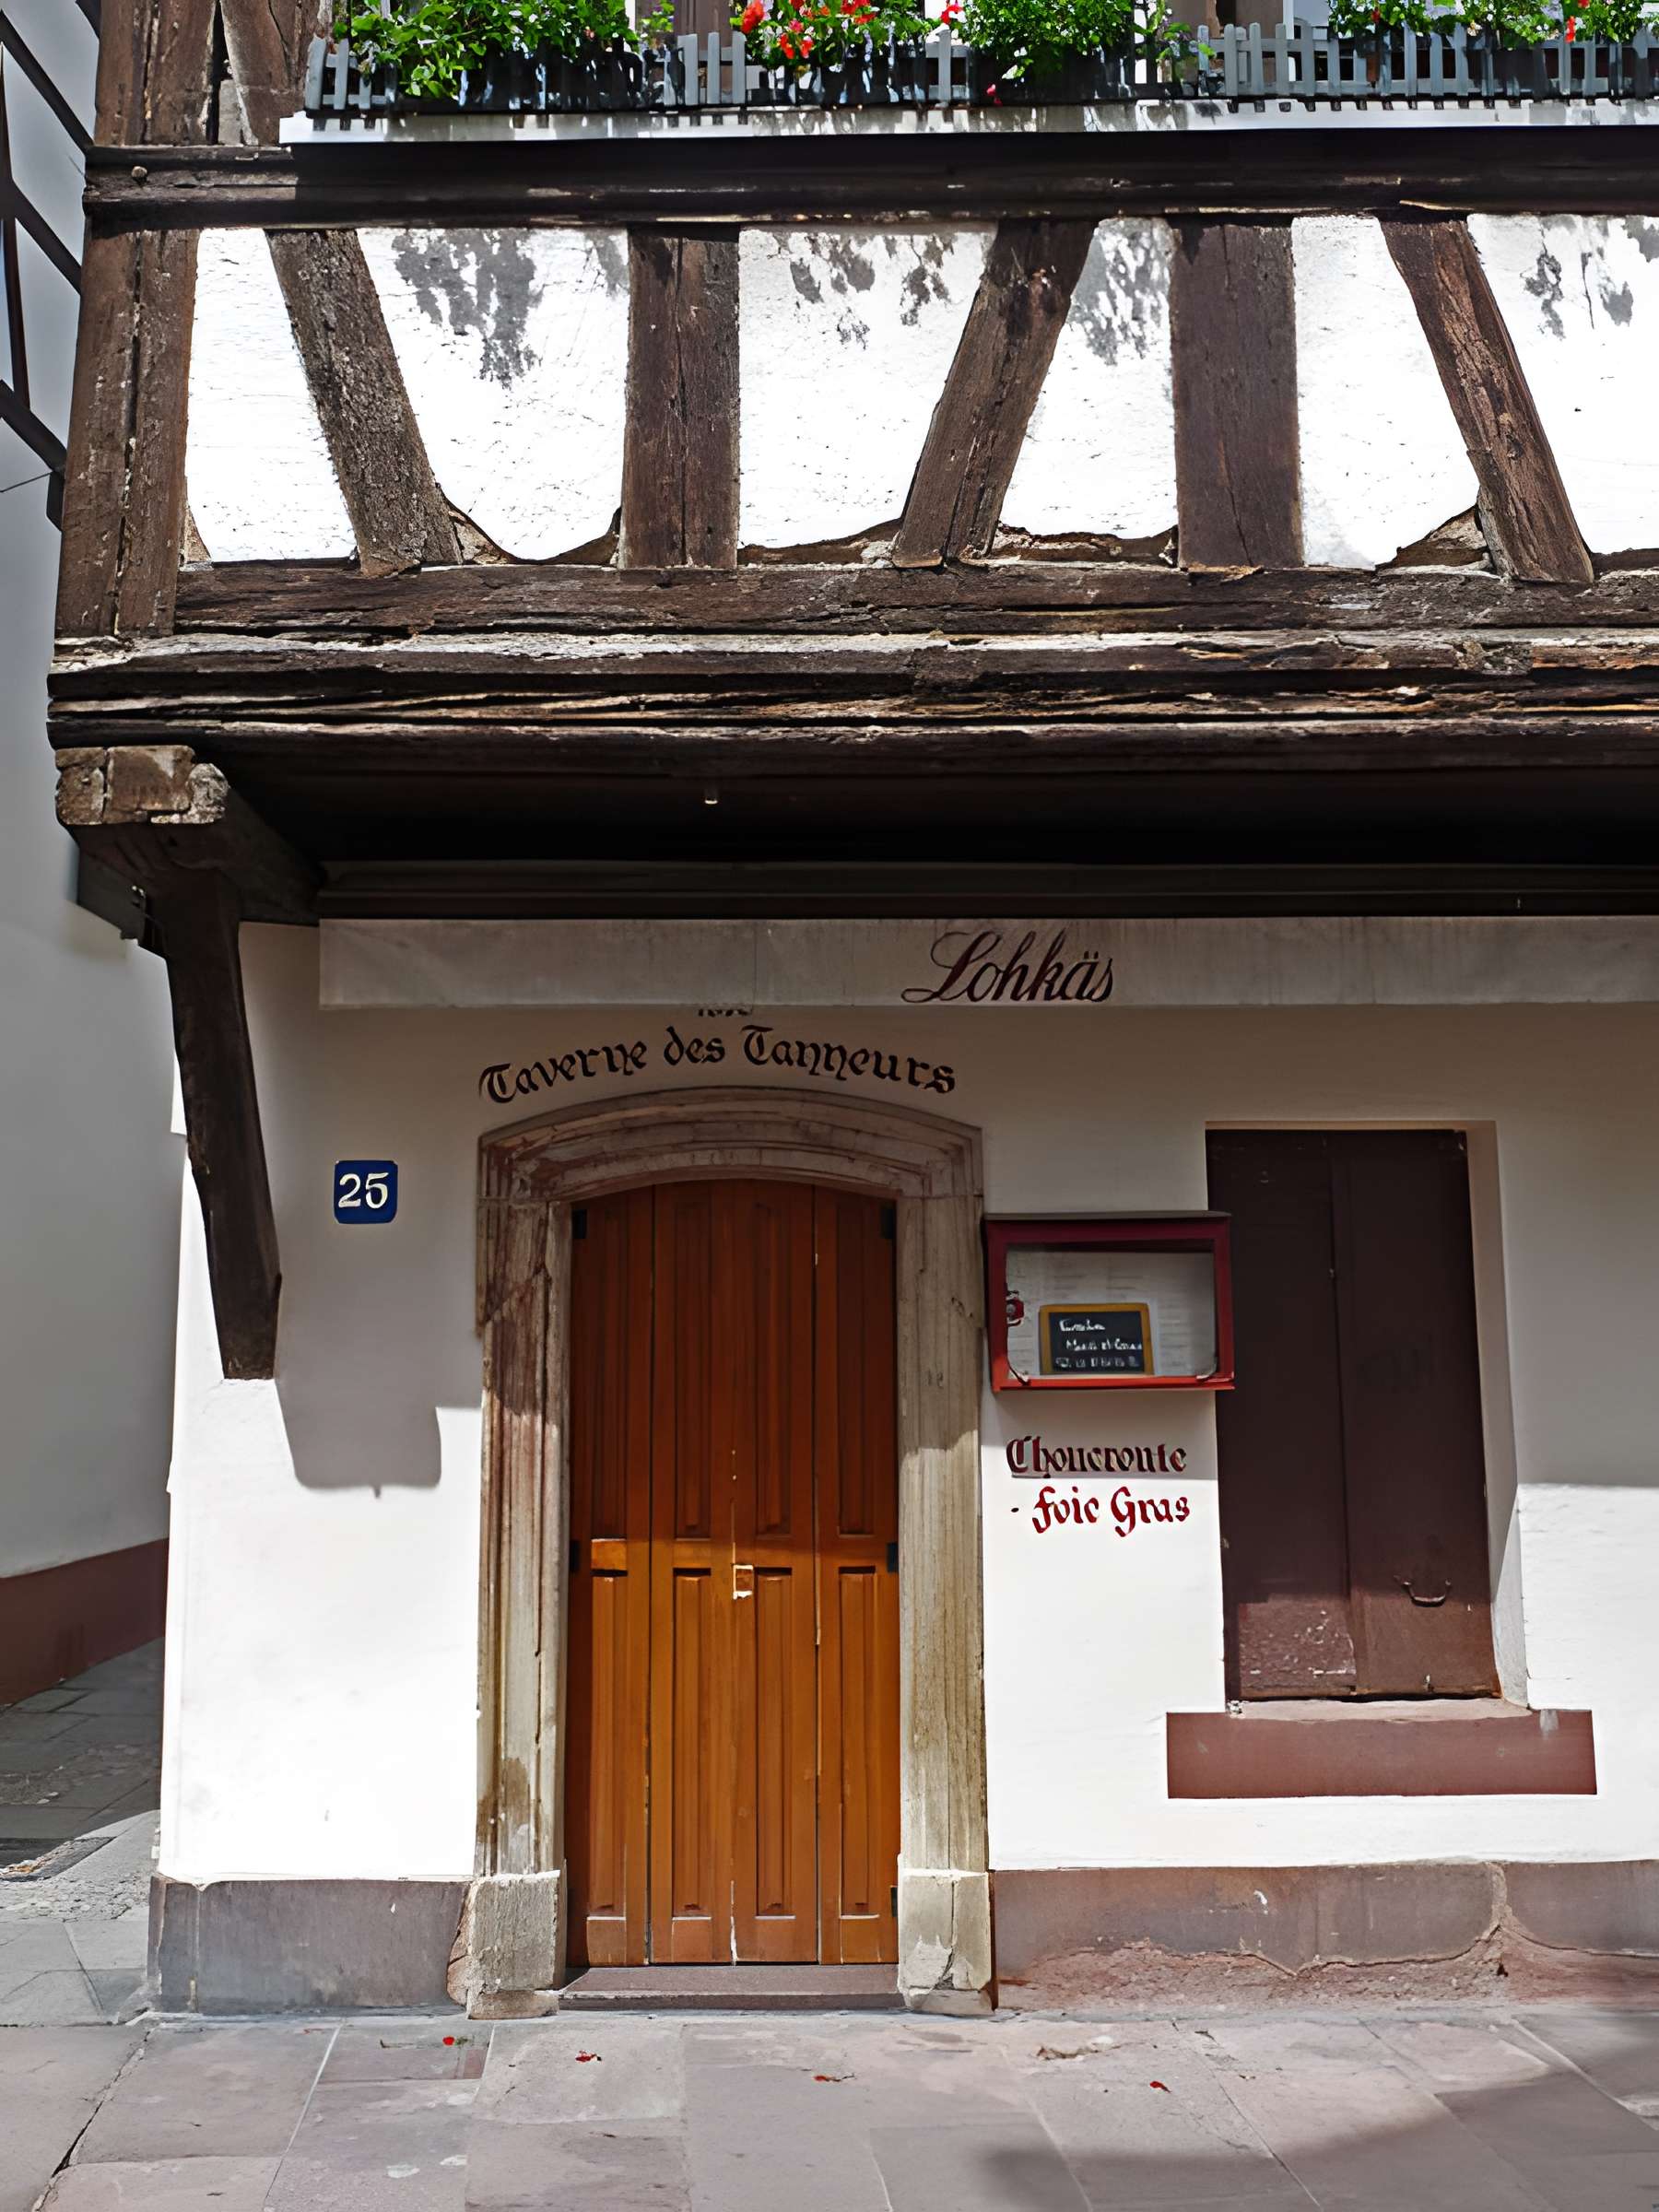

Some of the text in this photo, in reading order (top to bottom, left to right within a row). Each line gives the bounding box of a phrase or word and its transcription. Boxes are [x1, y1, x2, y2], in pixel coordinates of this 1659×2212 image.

[900, 927, 1112, 1003] Lohkäs
[478, 1025, 955, 1103] Taverne des Tanneurs
[338, 1172, 388, 1208] 25
[1006, 1436, 1186, 1478] Choucroute
[1111, 1487, 1190, 1537] Gras
